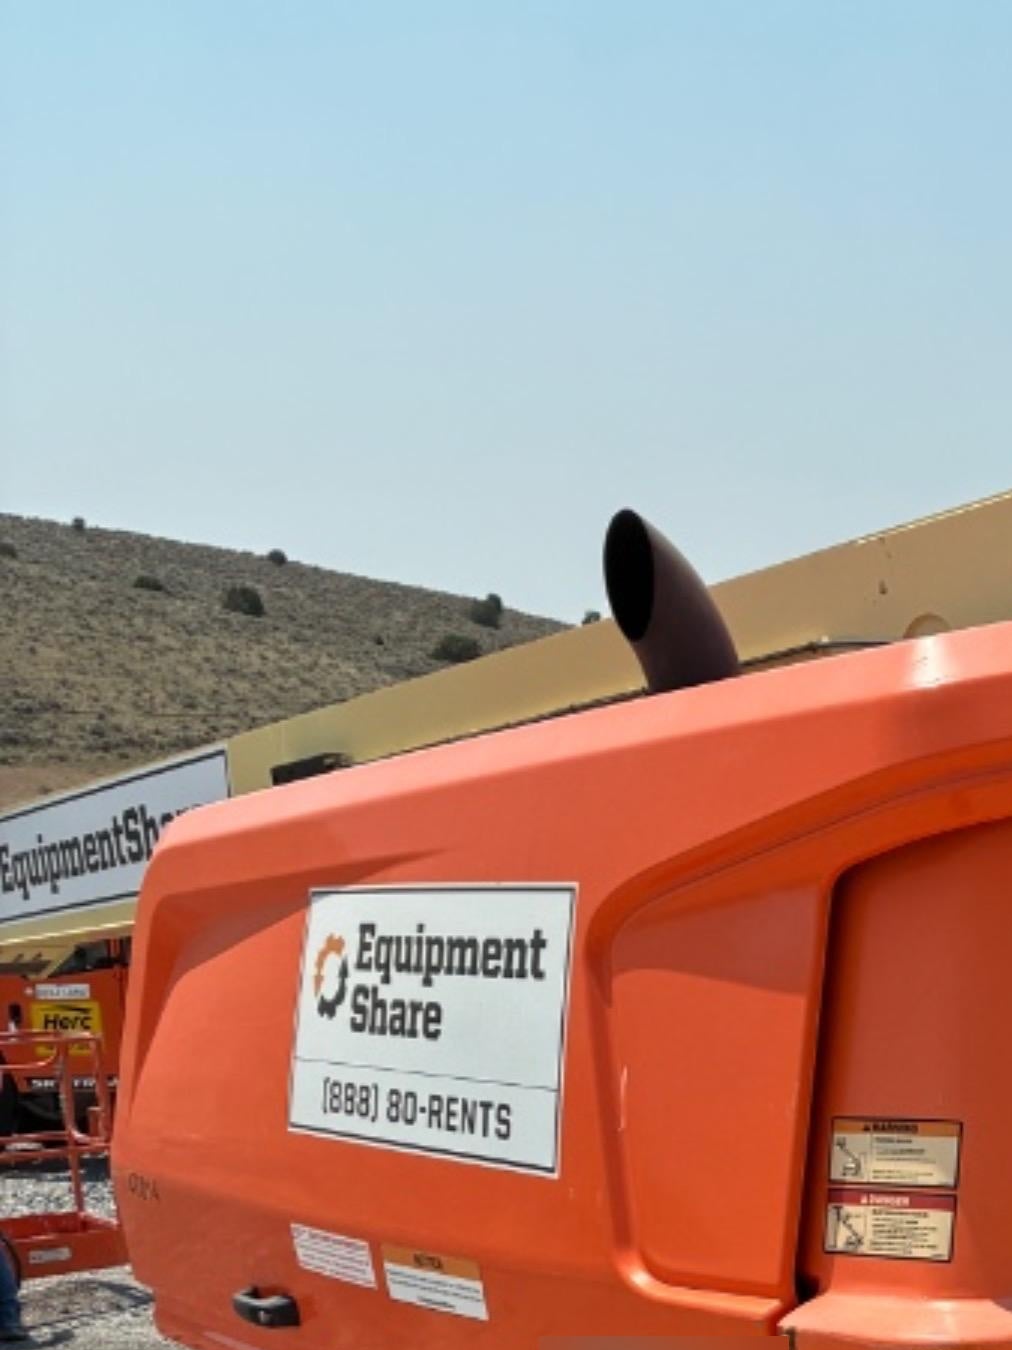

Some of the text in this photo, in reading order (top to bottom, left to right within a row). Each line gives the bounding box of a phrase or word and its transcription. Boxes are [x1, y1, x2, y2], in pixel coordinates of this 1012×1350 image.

[0, 804, 203, 900] EquipmentSh
[354, 923, 548, 987] Equipment
[350, 984, 443, 1041] Share
[323, 1077, 513, 1141] (888) 80-RENTS
